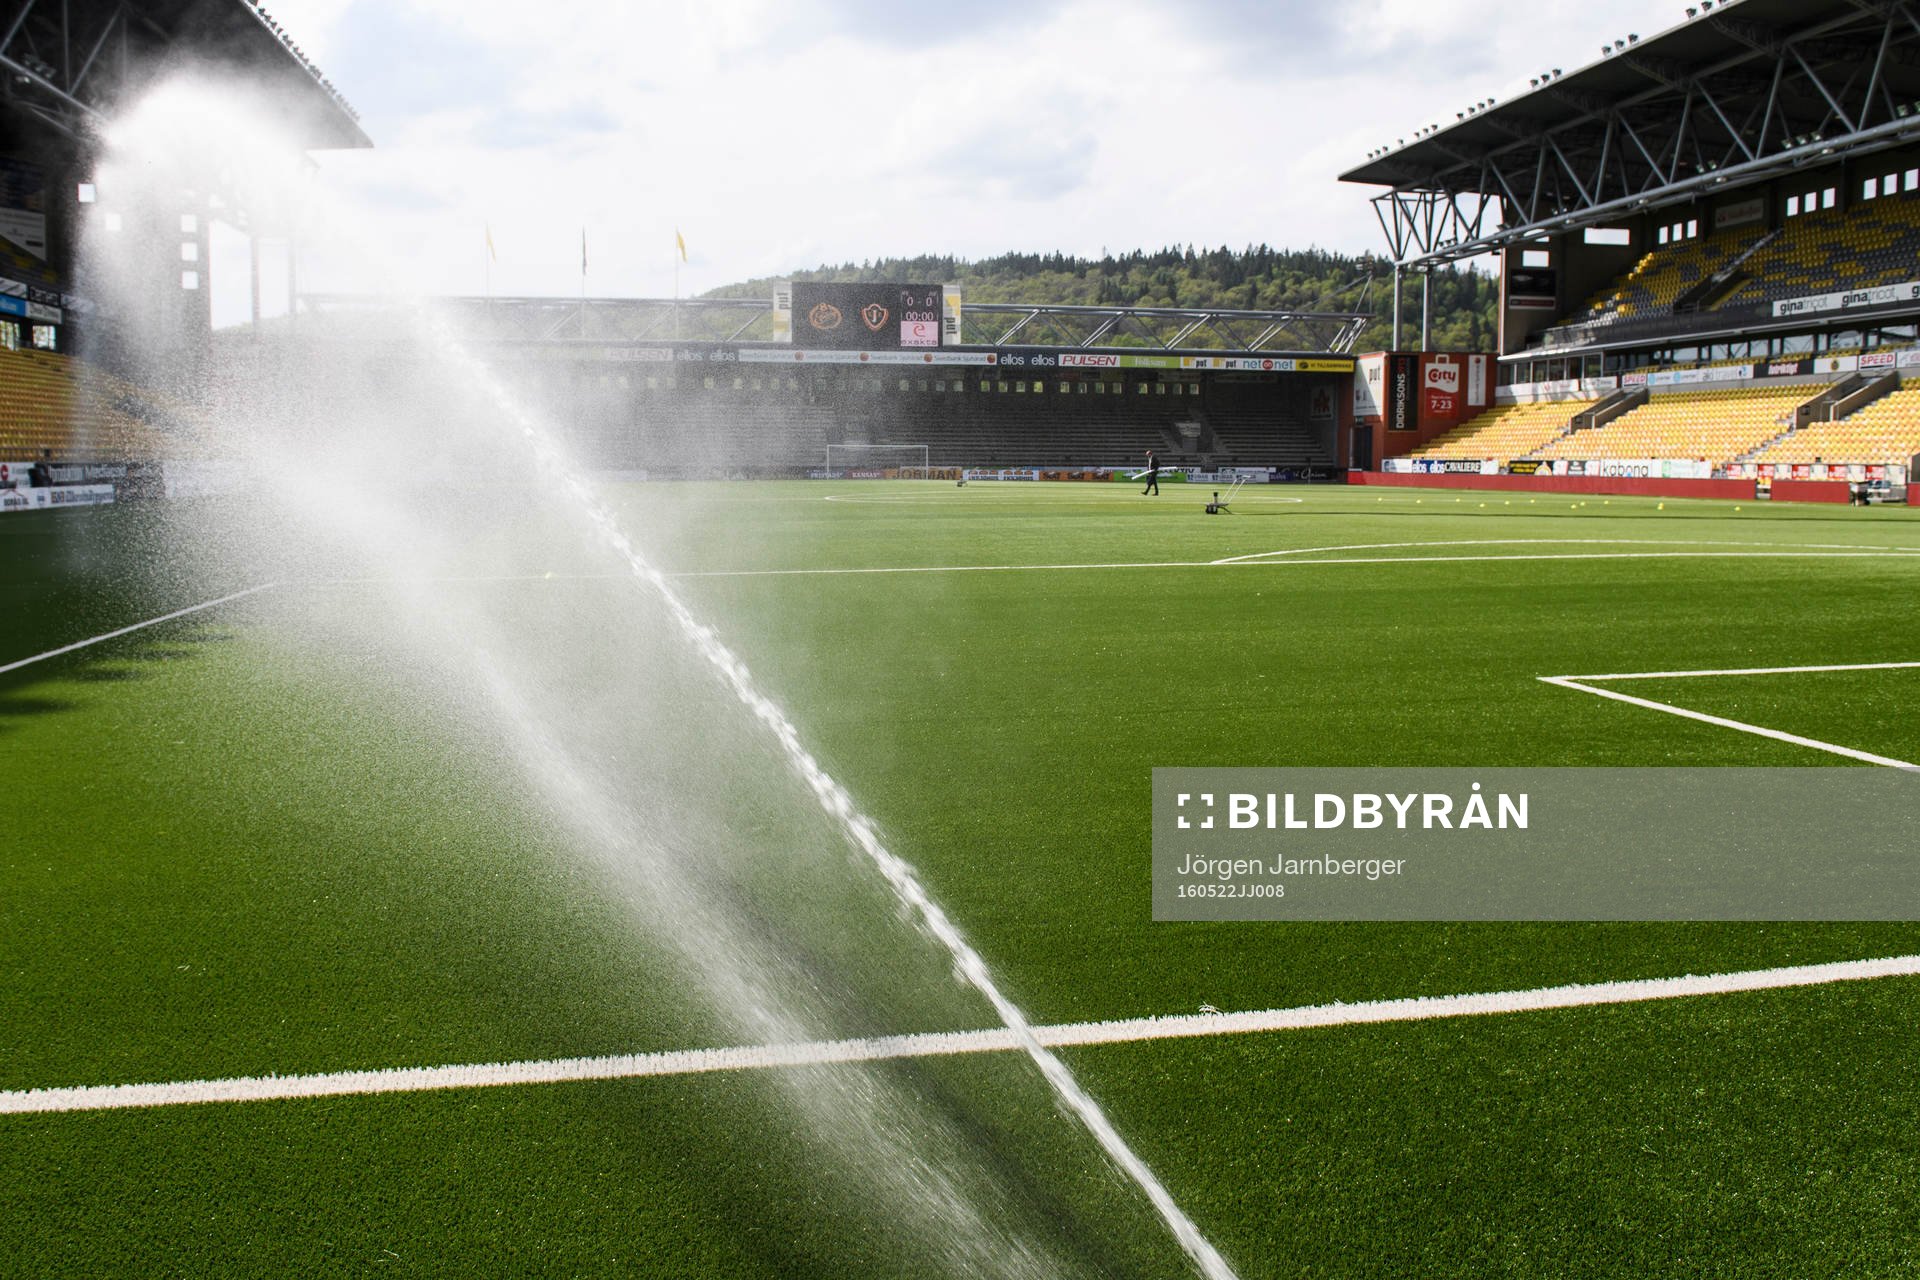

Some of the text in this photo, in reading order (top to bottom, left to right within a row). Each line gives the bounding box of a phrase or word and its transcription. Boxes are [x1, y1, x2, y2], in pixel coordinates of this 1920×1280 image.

[905, 311, 934, 321] 00:00
[1001, 354, 1055, 366] ellos ellos
[1062, 355, 1117, 366] PULSEN
[1861, 354, 1893, 365] SPEED
[1428, 368, 1456, 383] City
[1624, 375, 1645, 384] SPEED
[1396, 373, 1406, 429] DIDRIKSONS
[1431, 400, 1452, 409] 7-23
[1445, 462, 1481, 472] CAVALIERE
[1603, 460, 1649, 477] kabong
